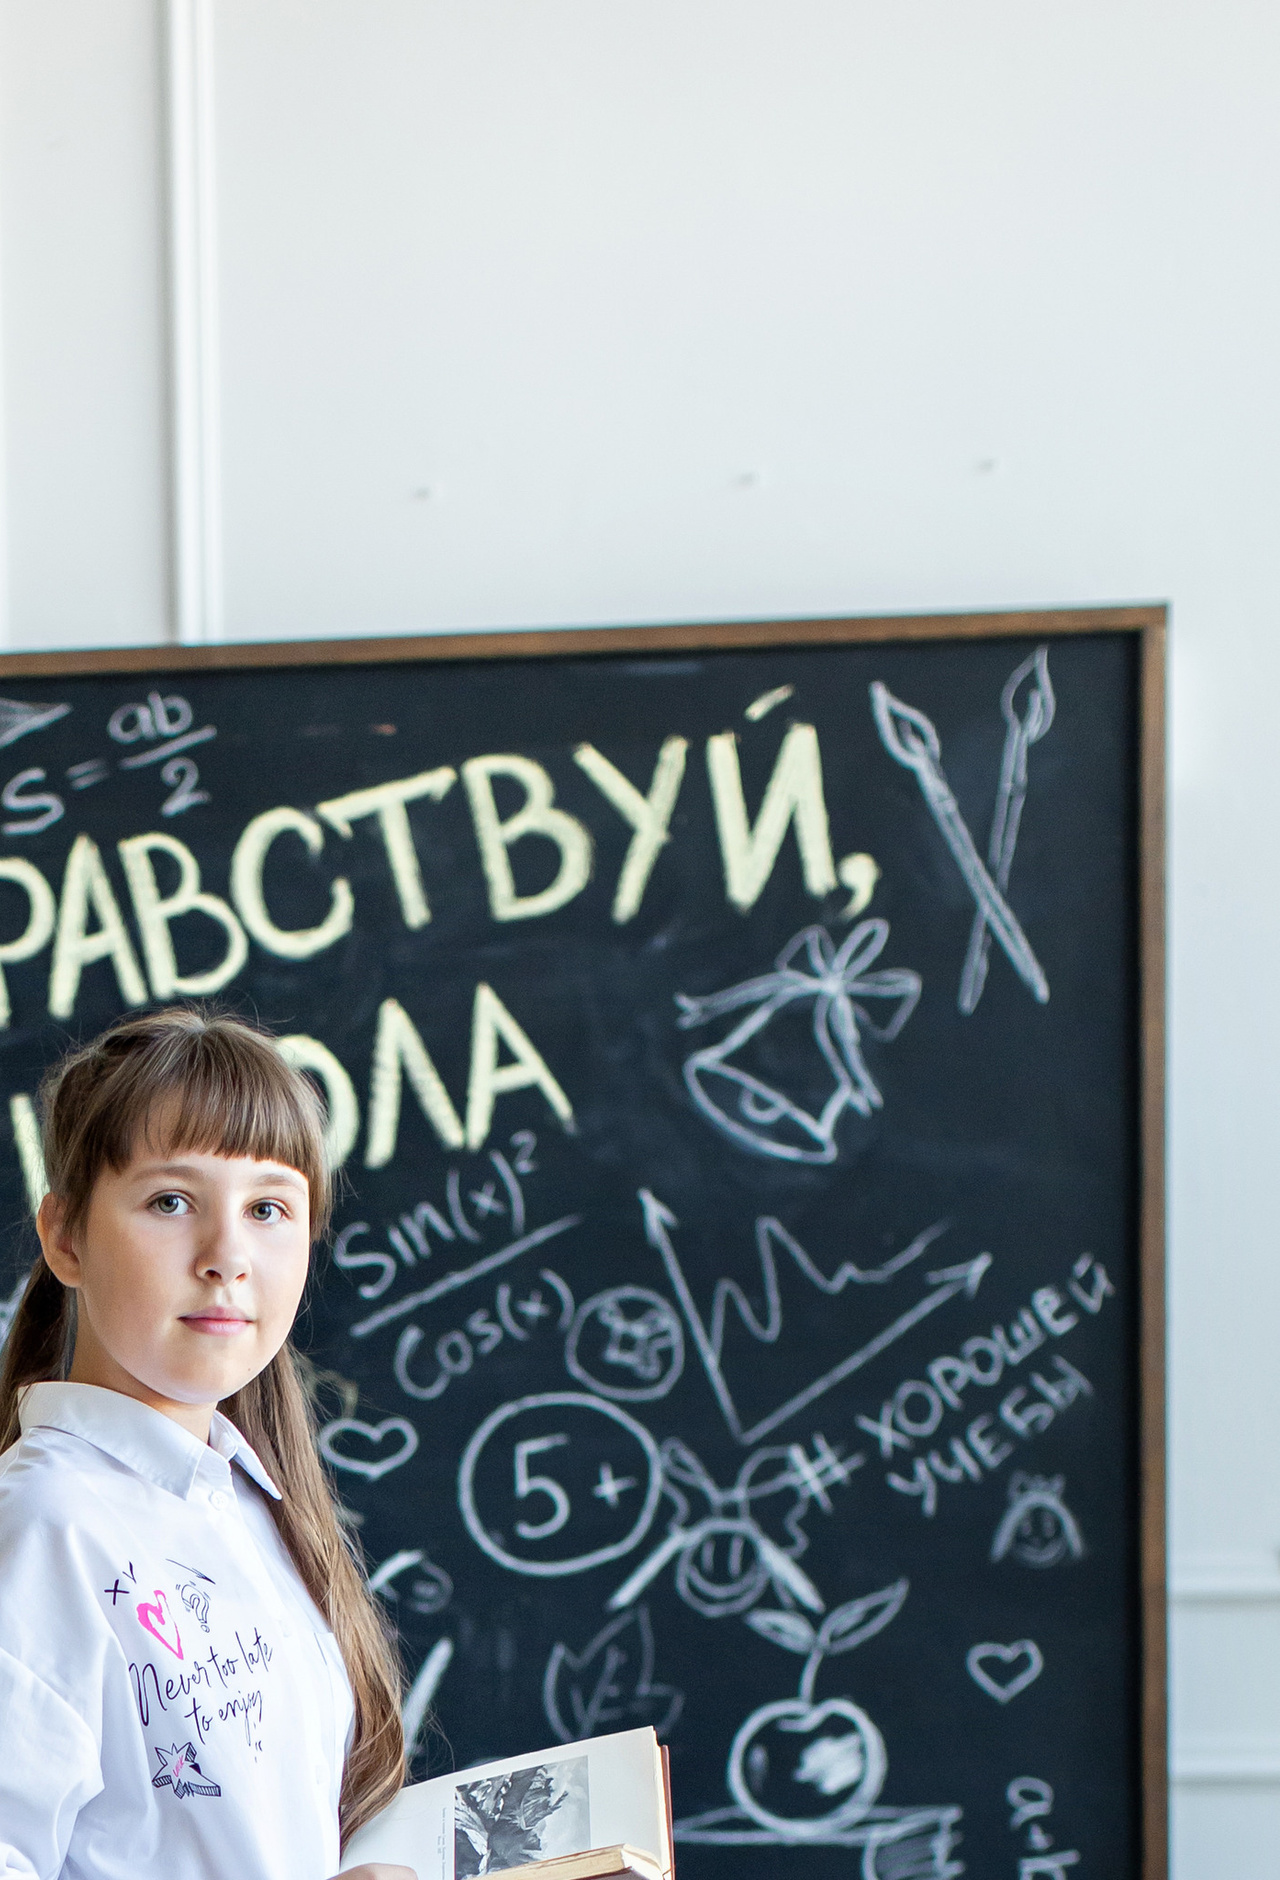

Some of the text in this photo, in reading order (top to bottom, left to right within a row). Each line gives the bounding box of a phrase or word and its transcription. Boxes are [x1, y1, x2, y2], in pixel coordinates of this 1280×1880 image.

[884, 1354, 1096, 1518] УЧЕБЫ
[128, 1626, 274, 1728] Never too late
[183, 1689, 264, 1748] to enjoy
